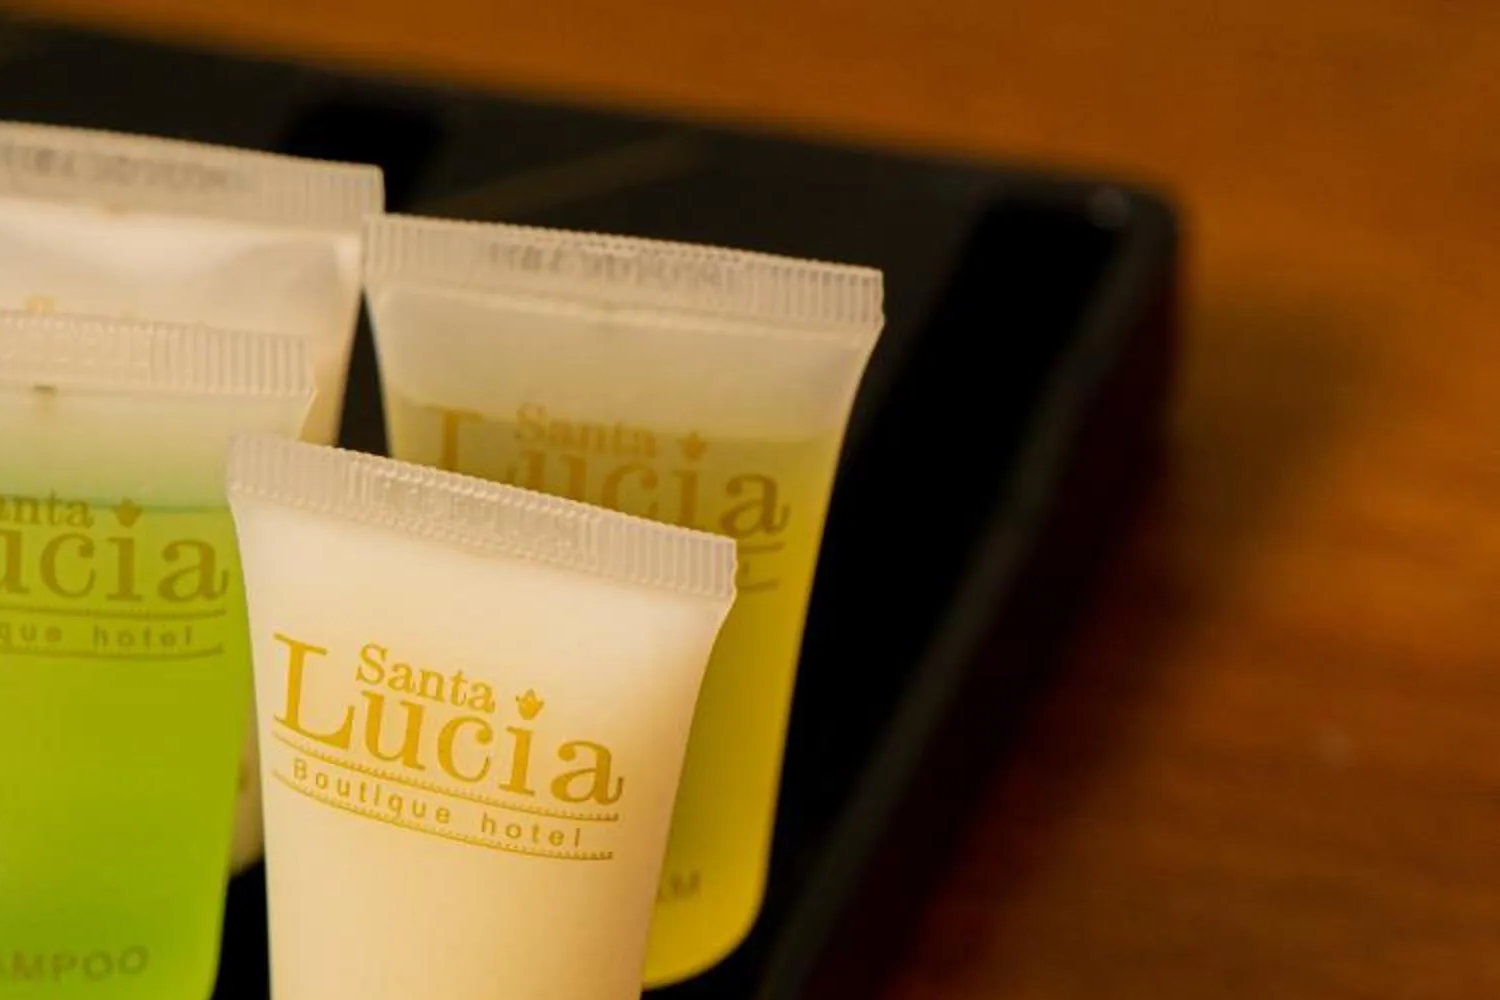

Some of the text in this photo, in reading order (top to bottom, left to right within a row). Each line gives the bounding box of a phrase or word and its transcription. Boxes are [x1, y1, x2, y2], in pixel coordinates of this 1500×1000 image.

[514, 403, 657, 460] Santa
[92, 624, 193, 648] hotel
[355, 643, 496, 713] Santa
[274, 633, 624, 805] Lucia
[293, 757, 581, 848] Boutique hotel
